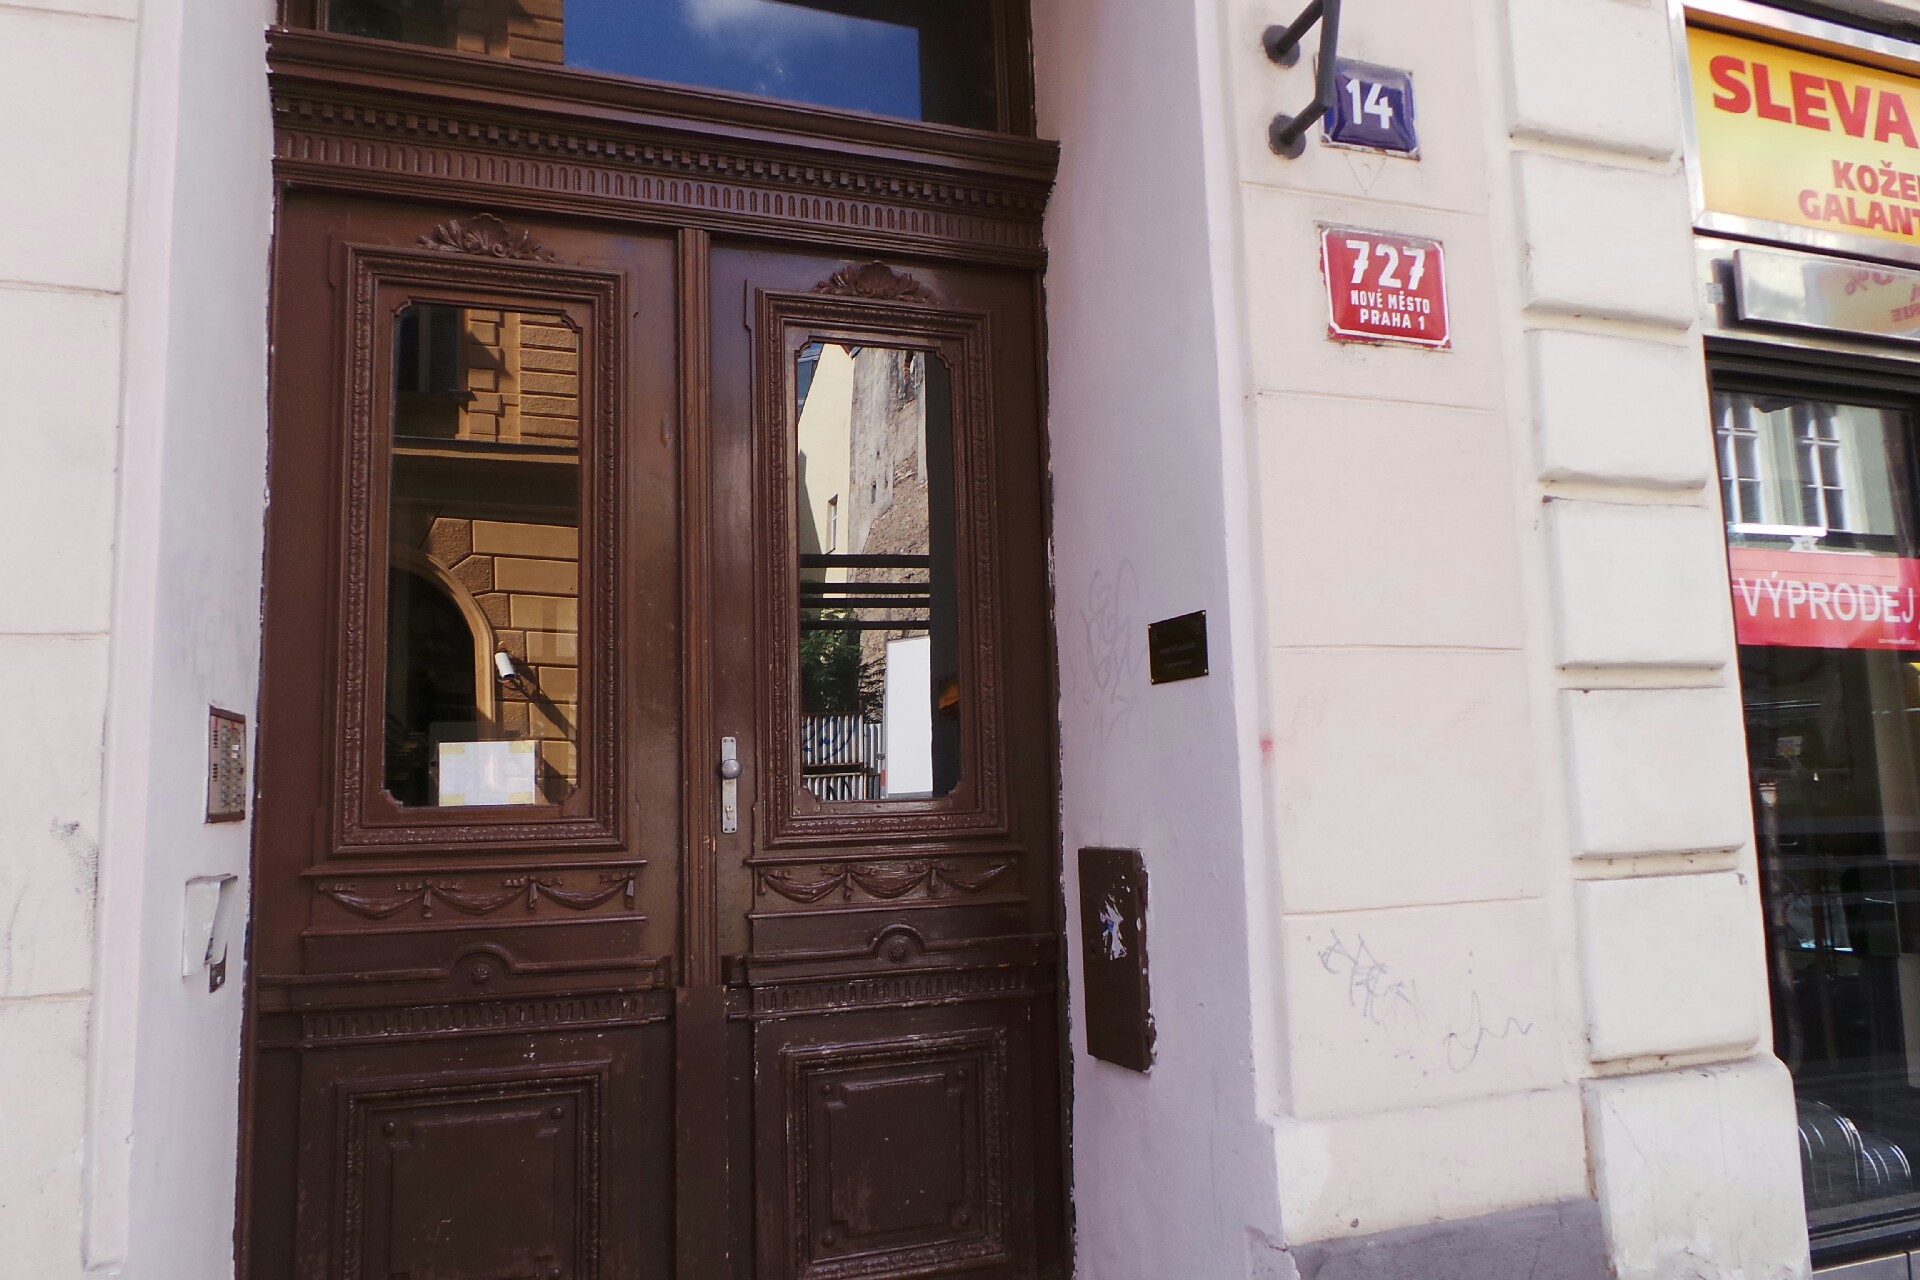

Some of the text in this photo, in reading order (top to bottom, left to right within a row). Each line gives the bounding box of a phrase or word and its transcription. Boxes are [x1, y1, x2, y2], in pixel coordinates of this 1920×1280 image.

[1345, 79, 1393, 129] 14
[1709, 55, 1919, 149] SLEVA
[1832, 159, 1920, 202] KOŽE
[1346, 239, 1425, 290] 727
[1350, 289, 1430, 314] NOVÉ MĚSTO
[1360, 308, 1425, 331] PRAHA 1
[1738, 571, 1914, 623] VÝPRODEJ
